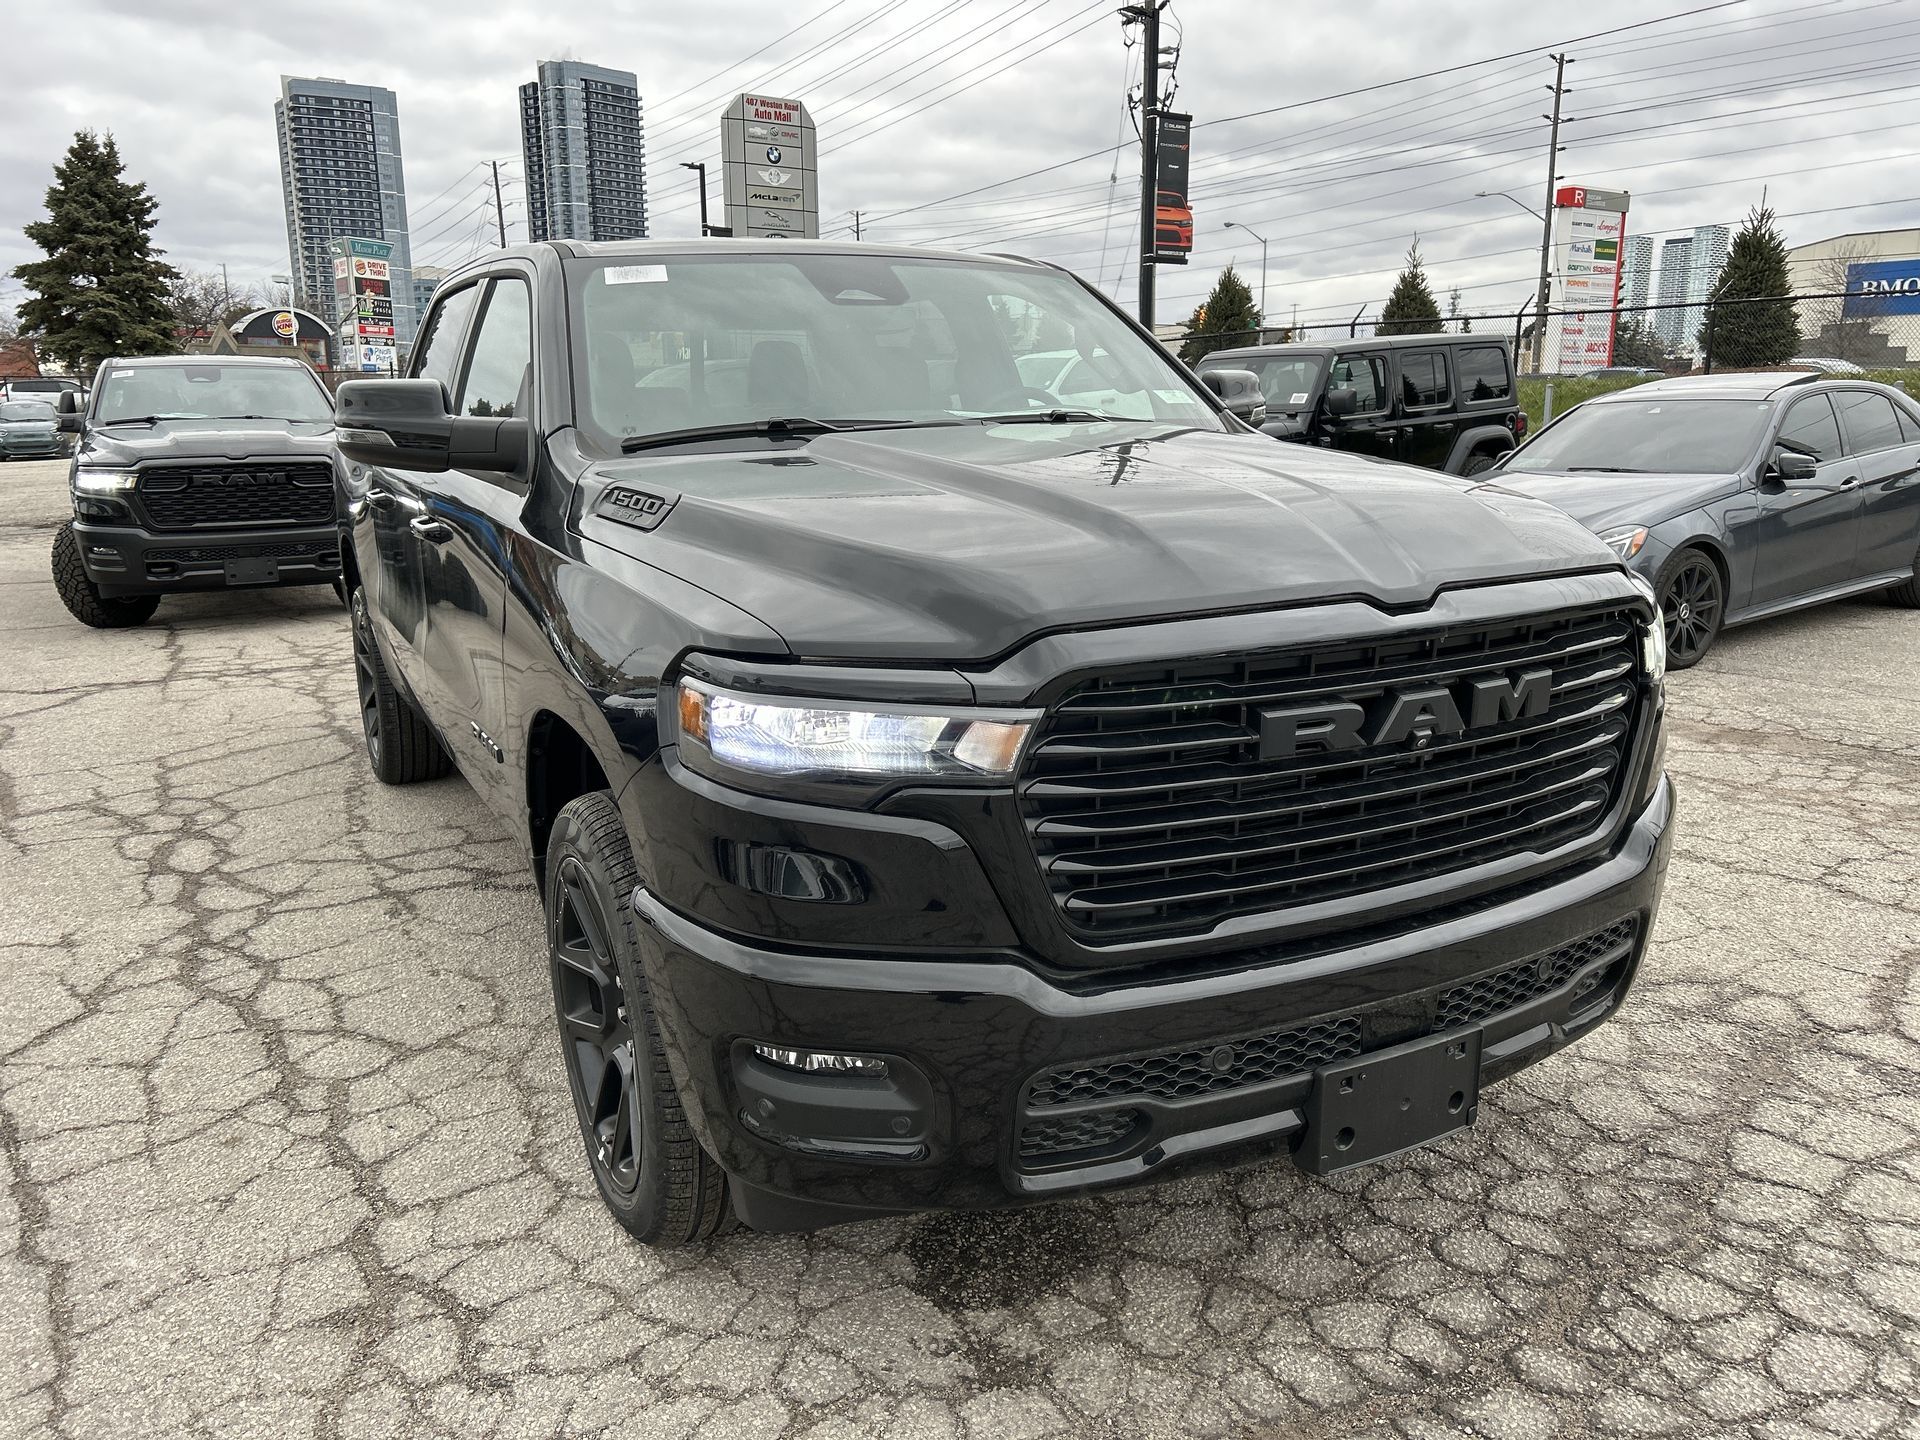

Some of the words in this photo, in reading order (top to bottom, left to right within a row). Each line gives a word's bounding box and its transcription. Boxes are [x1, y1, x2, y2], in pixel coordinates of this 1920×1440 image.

[745, 97, 758, 107] 407
[760, 99, 783, 110] Weston
[784, 103, 799, 112] Road
[754, 108, 772, 121] Auto
[774, 111, 792, 122] Mall
[750, 193, 796, 203] McLaren
[1574, 190, 1583, 204] R
[367, 261, 387, 270] DRIVE
[369, 269, 387, 277] THRU
[1860, 277, 1920, 298] BMO
[192, 472, 286, 486] RAM
[609, 488, 662, 514] 1500
[1260, 669, 1552, 760] RAM
